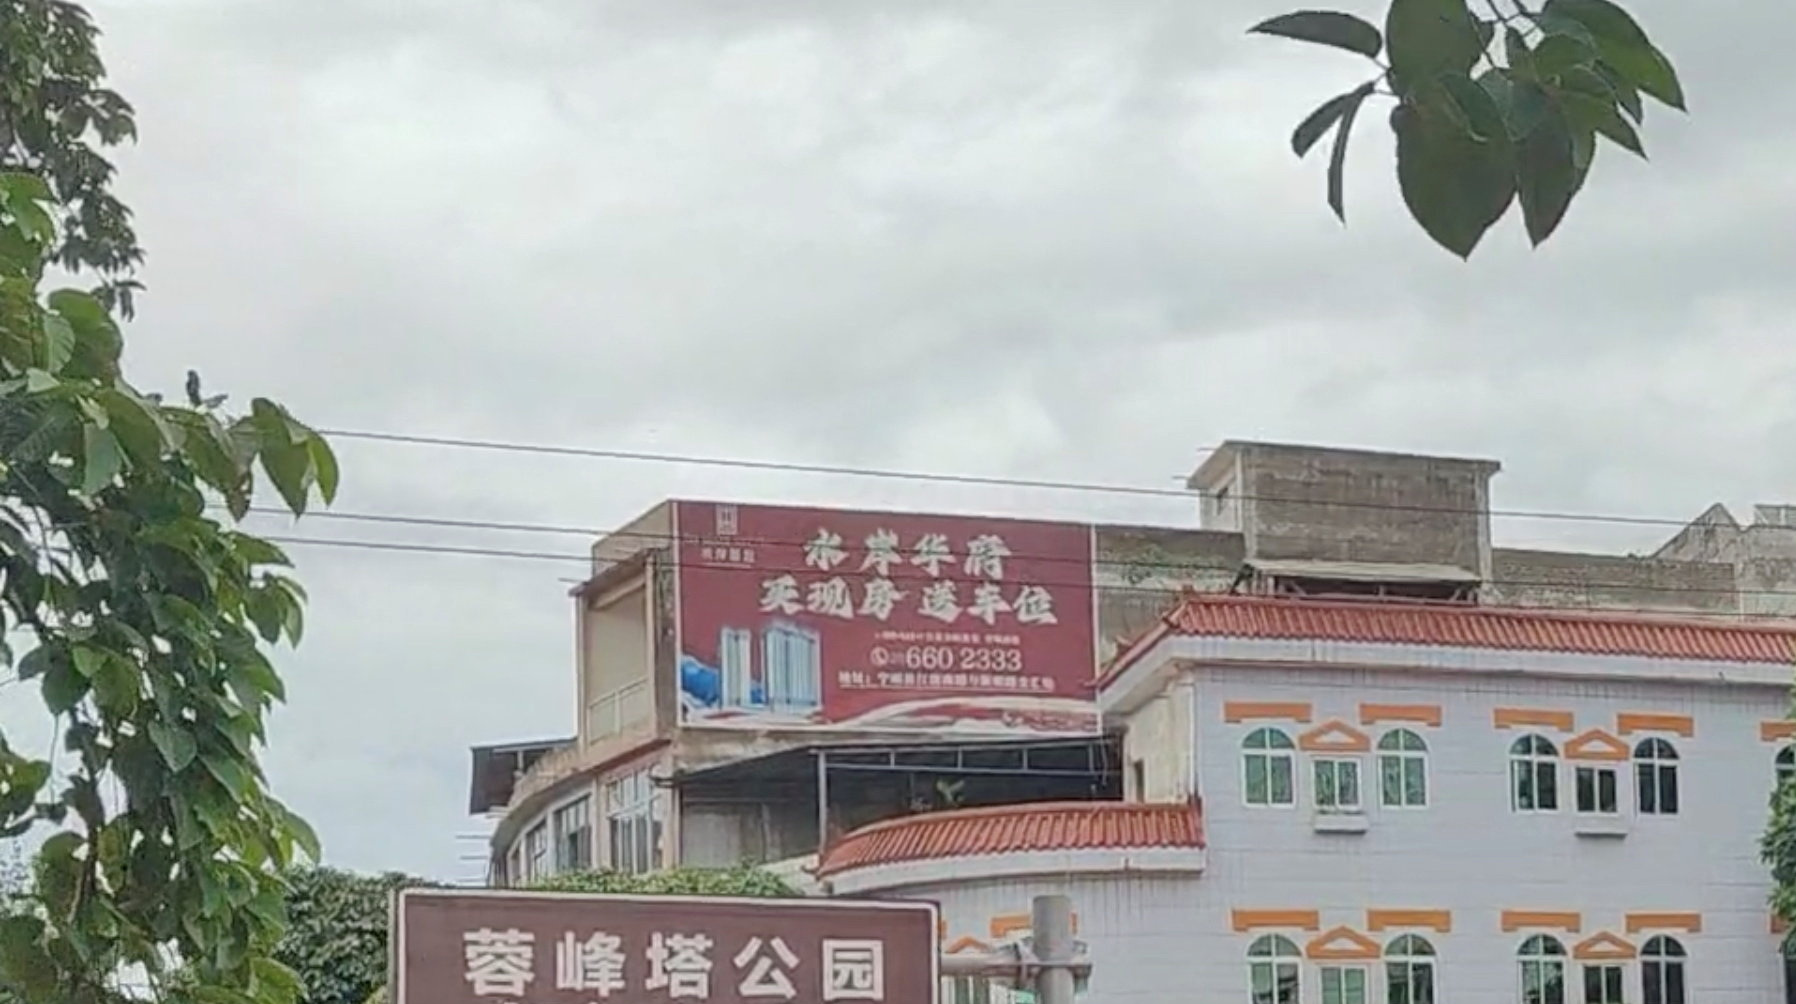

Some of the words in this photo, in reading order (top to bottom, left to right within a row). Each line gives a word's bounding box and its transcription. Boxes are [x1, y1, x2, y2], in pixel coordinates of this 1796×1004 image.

[906, 646, 953, 669] 660
[960, 647, 1022, 671] 2333
[463, 927, 884, 1002] 蓉峰塔公园
